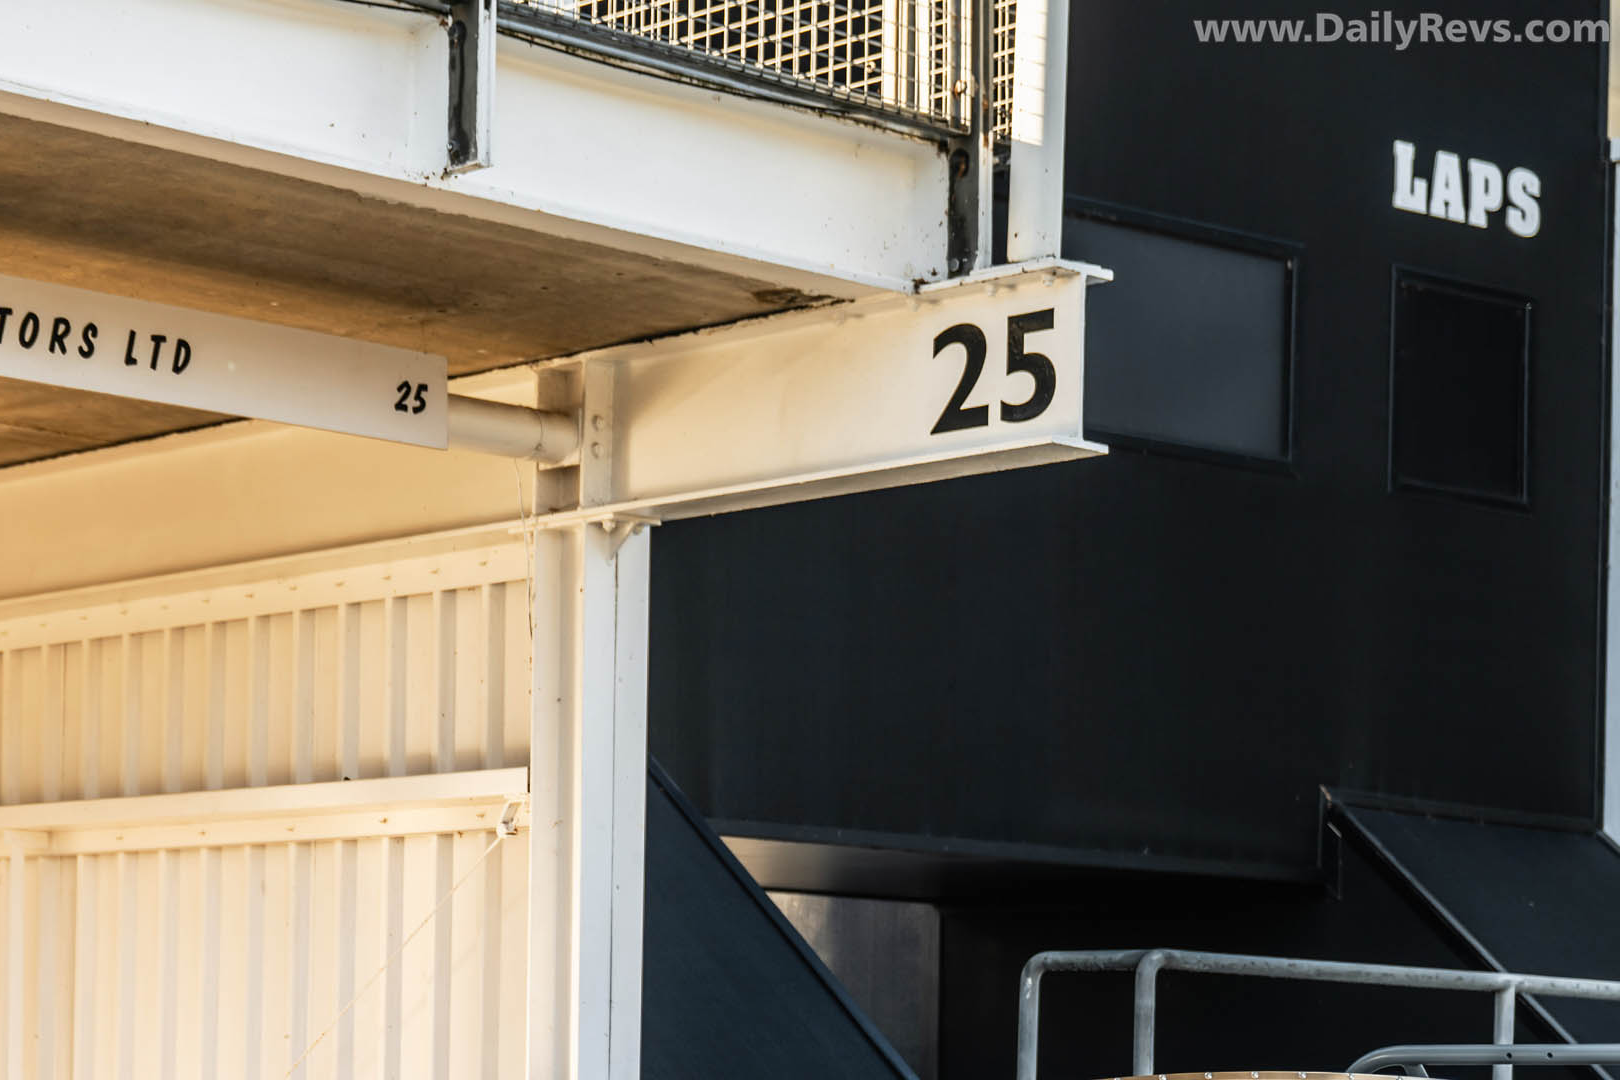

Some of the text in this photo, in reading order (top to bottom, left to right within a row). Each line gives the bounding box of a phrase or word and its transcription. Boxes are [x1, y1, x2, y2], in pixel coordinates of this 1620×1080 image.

[1392, 139, 1541, 238] LAPS
[124, 329, 192, 375] LTD
[394, 380, 429, 415] 25
[930, 307, 1057, 436] 25
